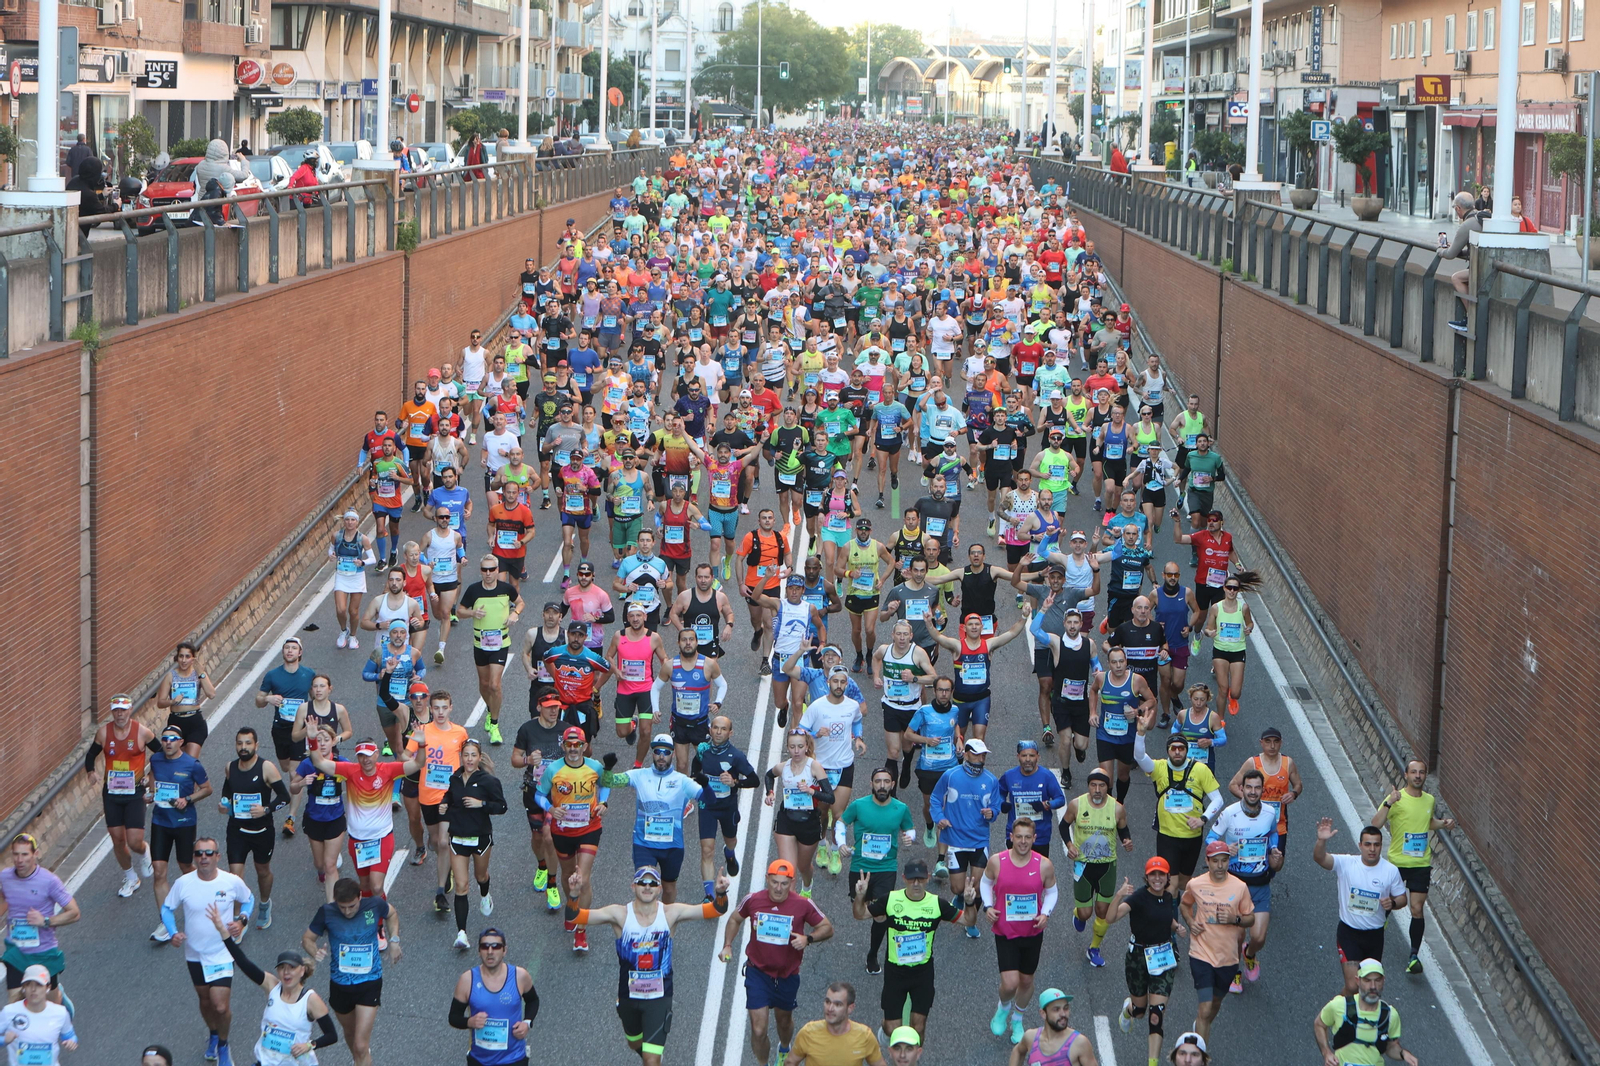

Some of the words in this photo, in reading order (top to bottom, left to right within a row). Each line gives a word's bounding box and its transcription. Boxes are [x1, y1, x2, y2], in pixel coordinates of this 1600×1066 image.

[1313, 8, 1321, 70] JENTOFT
[1315, 123, 1327, 138] P
[427, 747, 443, 759] 20
[894, 917, 932, 927] TALENTOS
[272, 1029, 291, 1038] ZURICH
